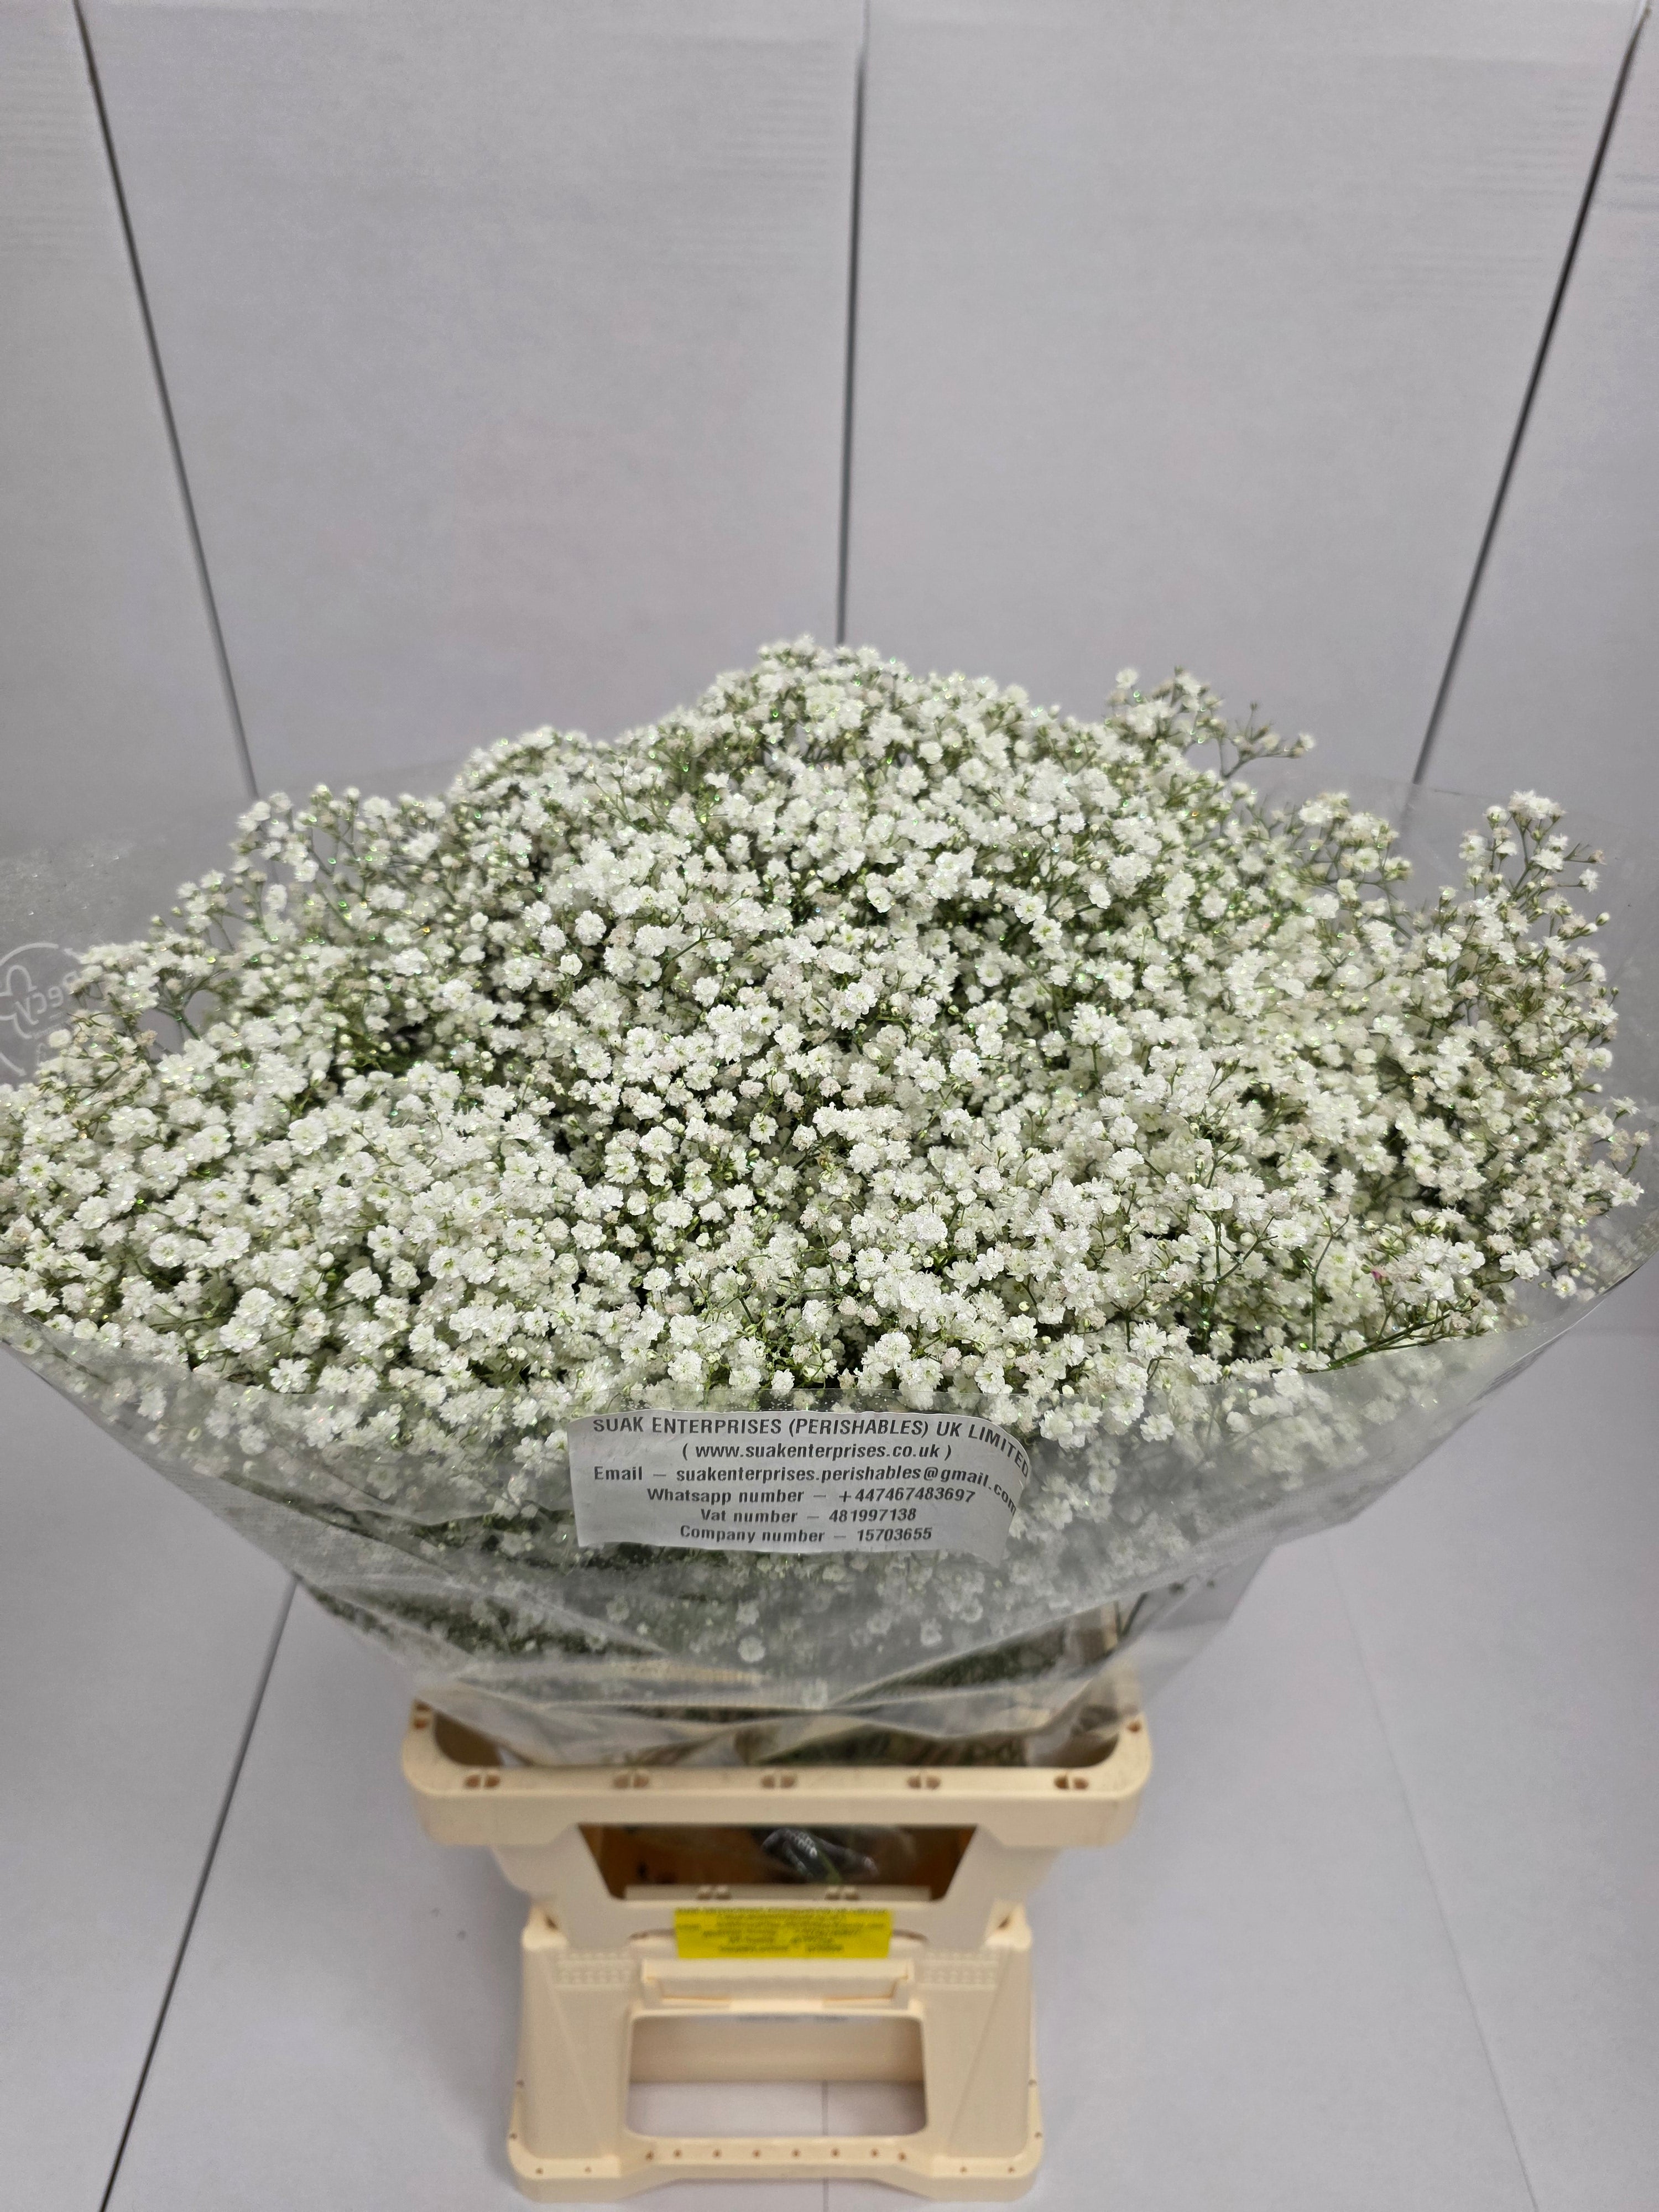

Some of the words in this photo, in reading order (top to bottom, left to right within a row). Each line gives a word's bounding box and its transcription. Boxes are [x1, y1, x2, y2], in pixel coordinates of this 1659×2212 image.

[593, 1417, 644, 1433] SUAK
[652, 1417, 782, 1434] ENTERPRISES
[789, 1418, 928, 1438] (PERISHABLES)
[936, 1421, 963, 1437] UK
[968, 1422, 1029, 1478] LIMITED
[696, 1443, 940, 1461] www.suakenterprises.co.uk
[594, 1465, 643, 1480] Email
[676, 1466, 1017, 1516] suakenterprises.perishables@gmail.com
[646, 1488, 731, 1505] Whatsapp
[738, 1489, 805, 1503] number
[838, 1487, 976, 1503] +447467483697
[700, 1508, 727, 1522] Vat
[733, 1510, 798, 1523] number
[829, 1507, 917, 1522] 481997138
[680, 1525, 756, 1543] Company
[761, 1528, 825, 1542] number
[857, 1527, 933, 1542] 15703655
